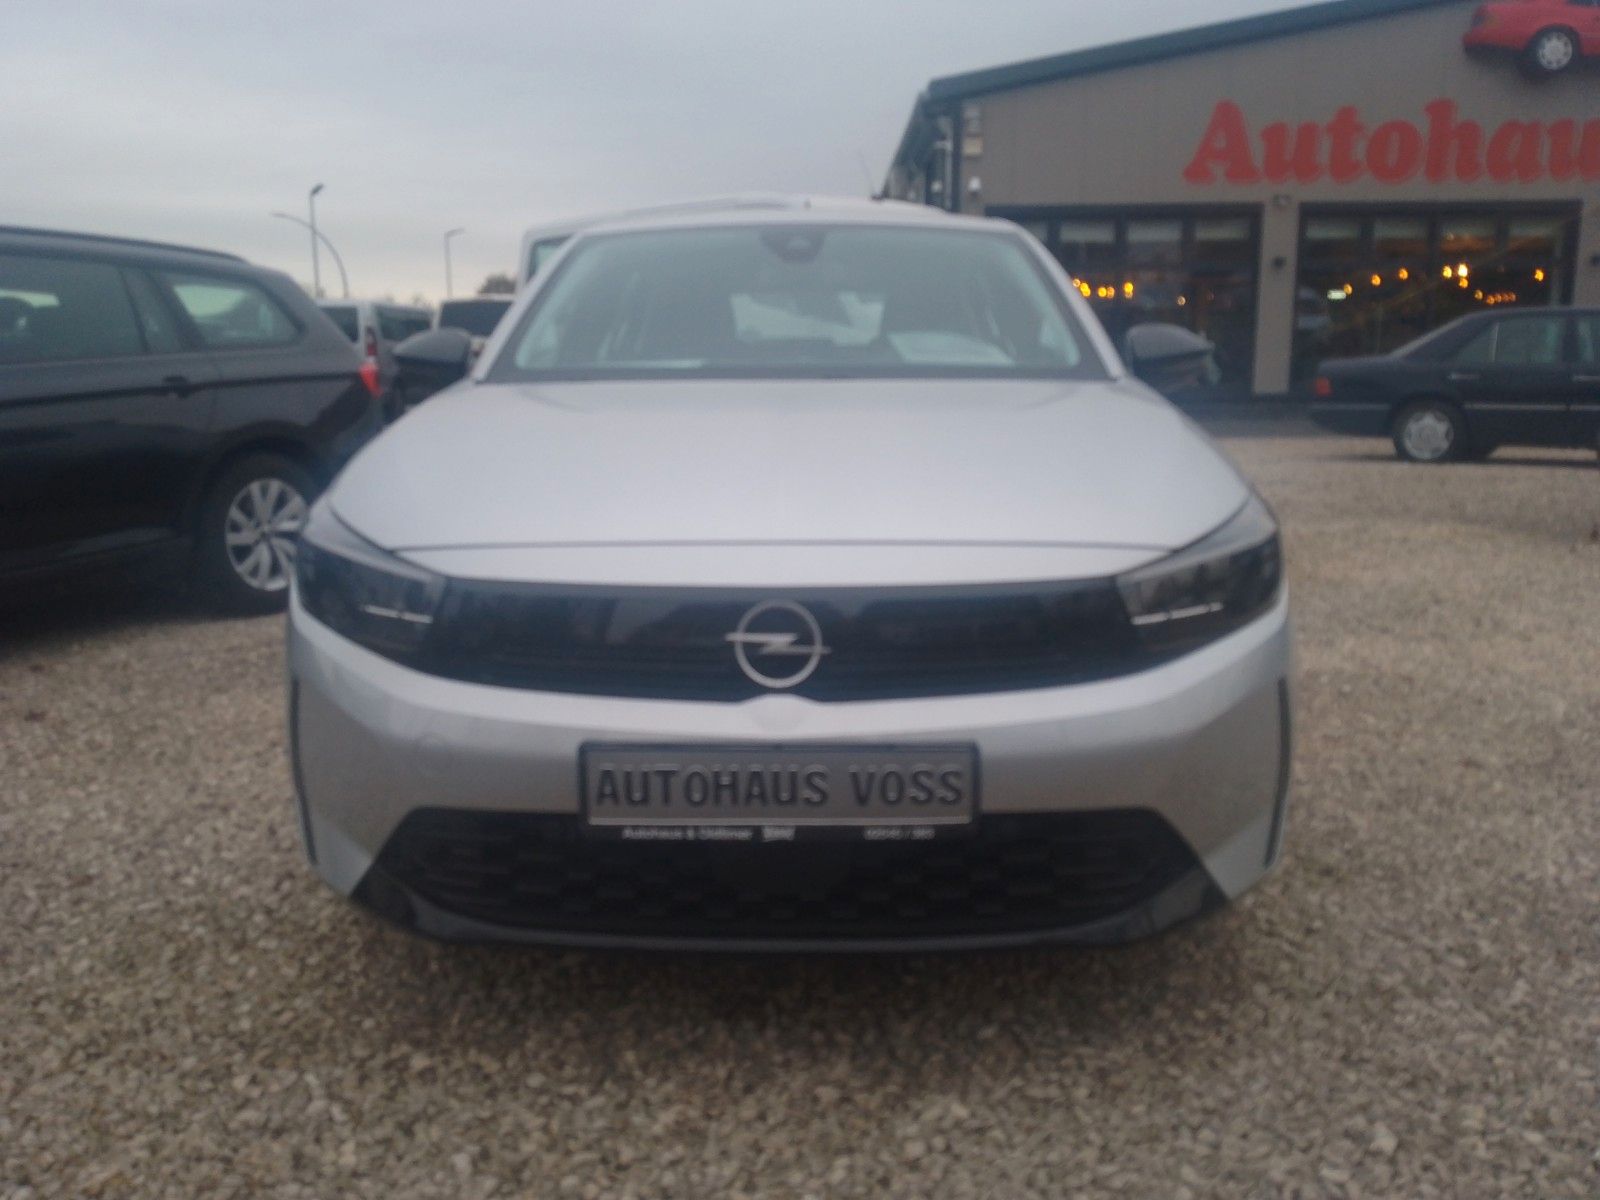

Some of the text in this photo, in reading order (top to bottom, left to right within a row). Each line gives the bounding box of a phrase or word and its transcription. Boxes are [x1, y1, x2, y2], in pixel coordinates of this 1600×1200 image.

[1184, 98, 1600, 183] Autohau
[597, 766, 963, 806] AUTOHAUS VOSS
